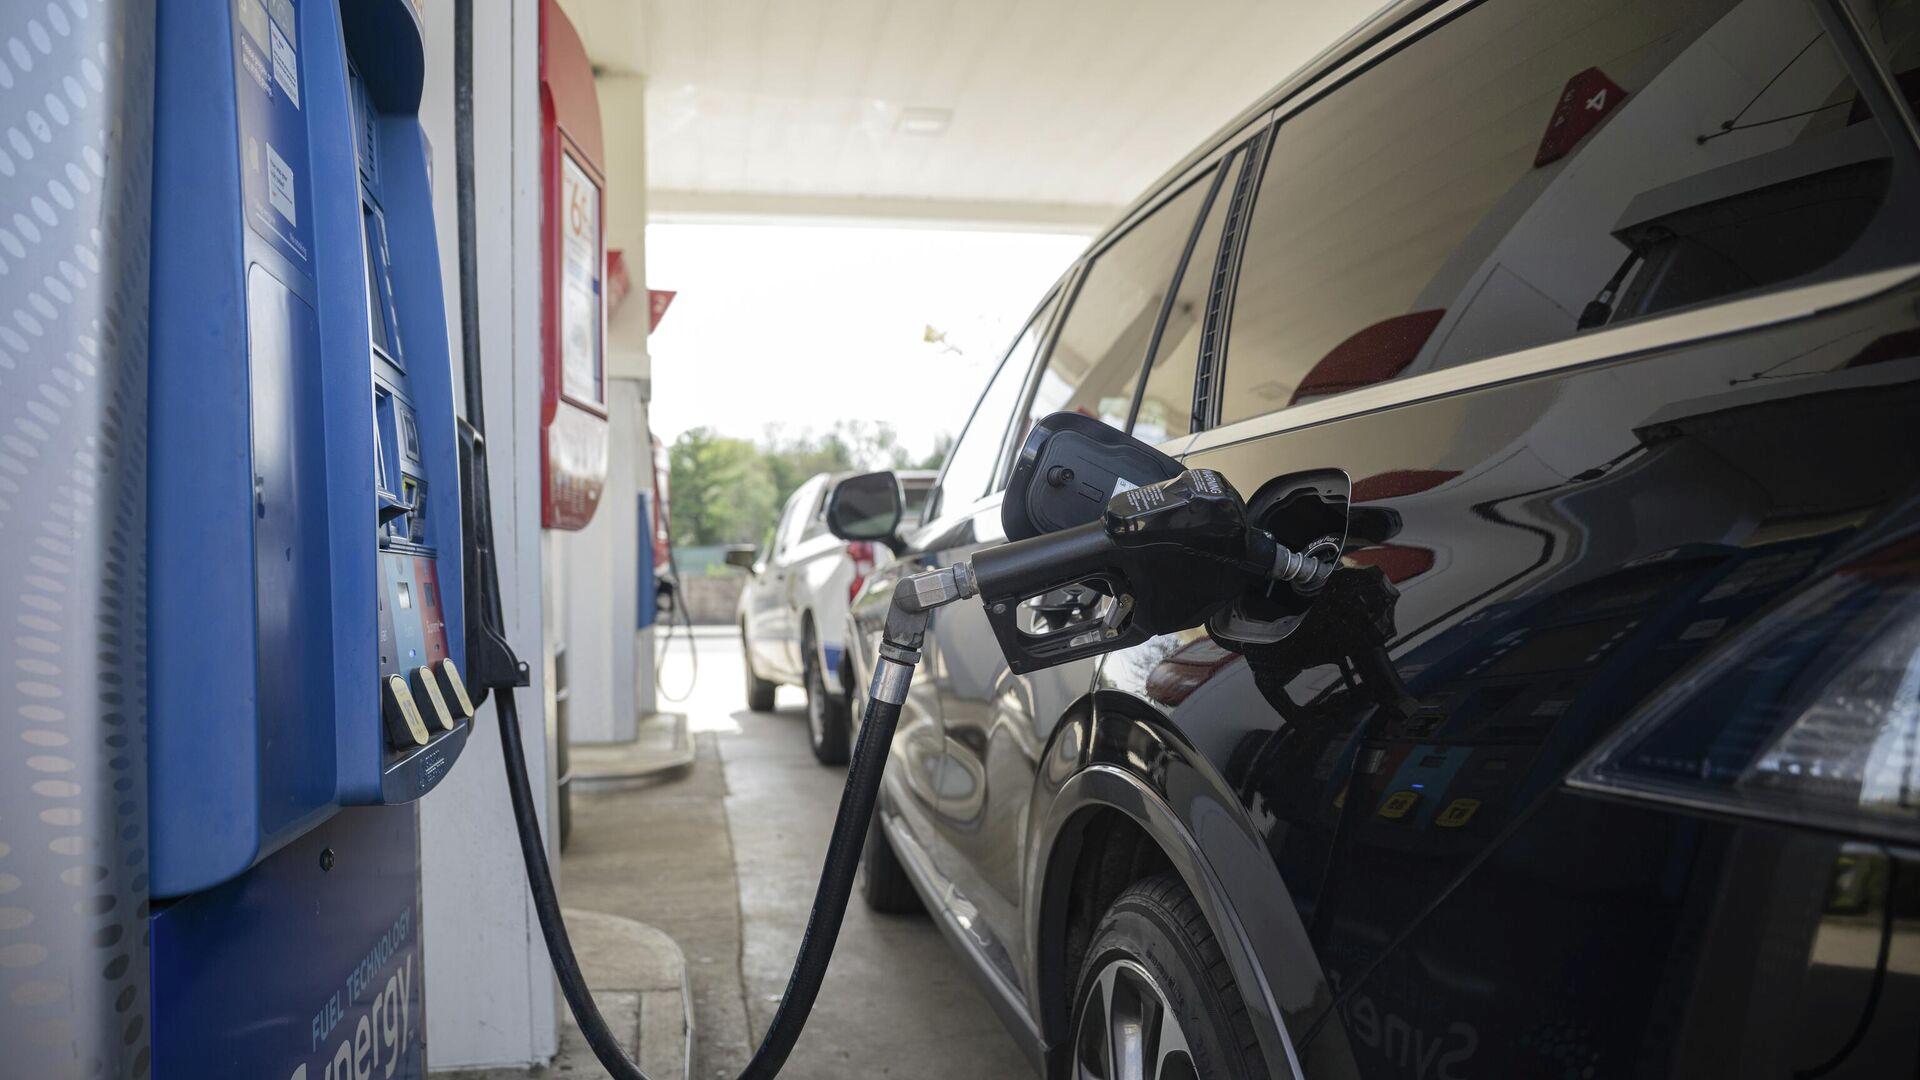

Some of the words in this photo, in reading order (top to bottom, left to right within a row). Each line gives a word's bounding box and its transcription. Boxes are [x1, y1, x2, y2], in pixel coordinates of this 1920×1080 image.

[290, 953, 411, 1080] nergy
[312, 990, 344, 1053] FUEL
[346, 907, 410, 1007] TECHNOLOGY
